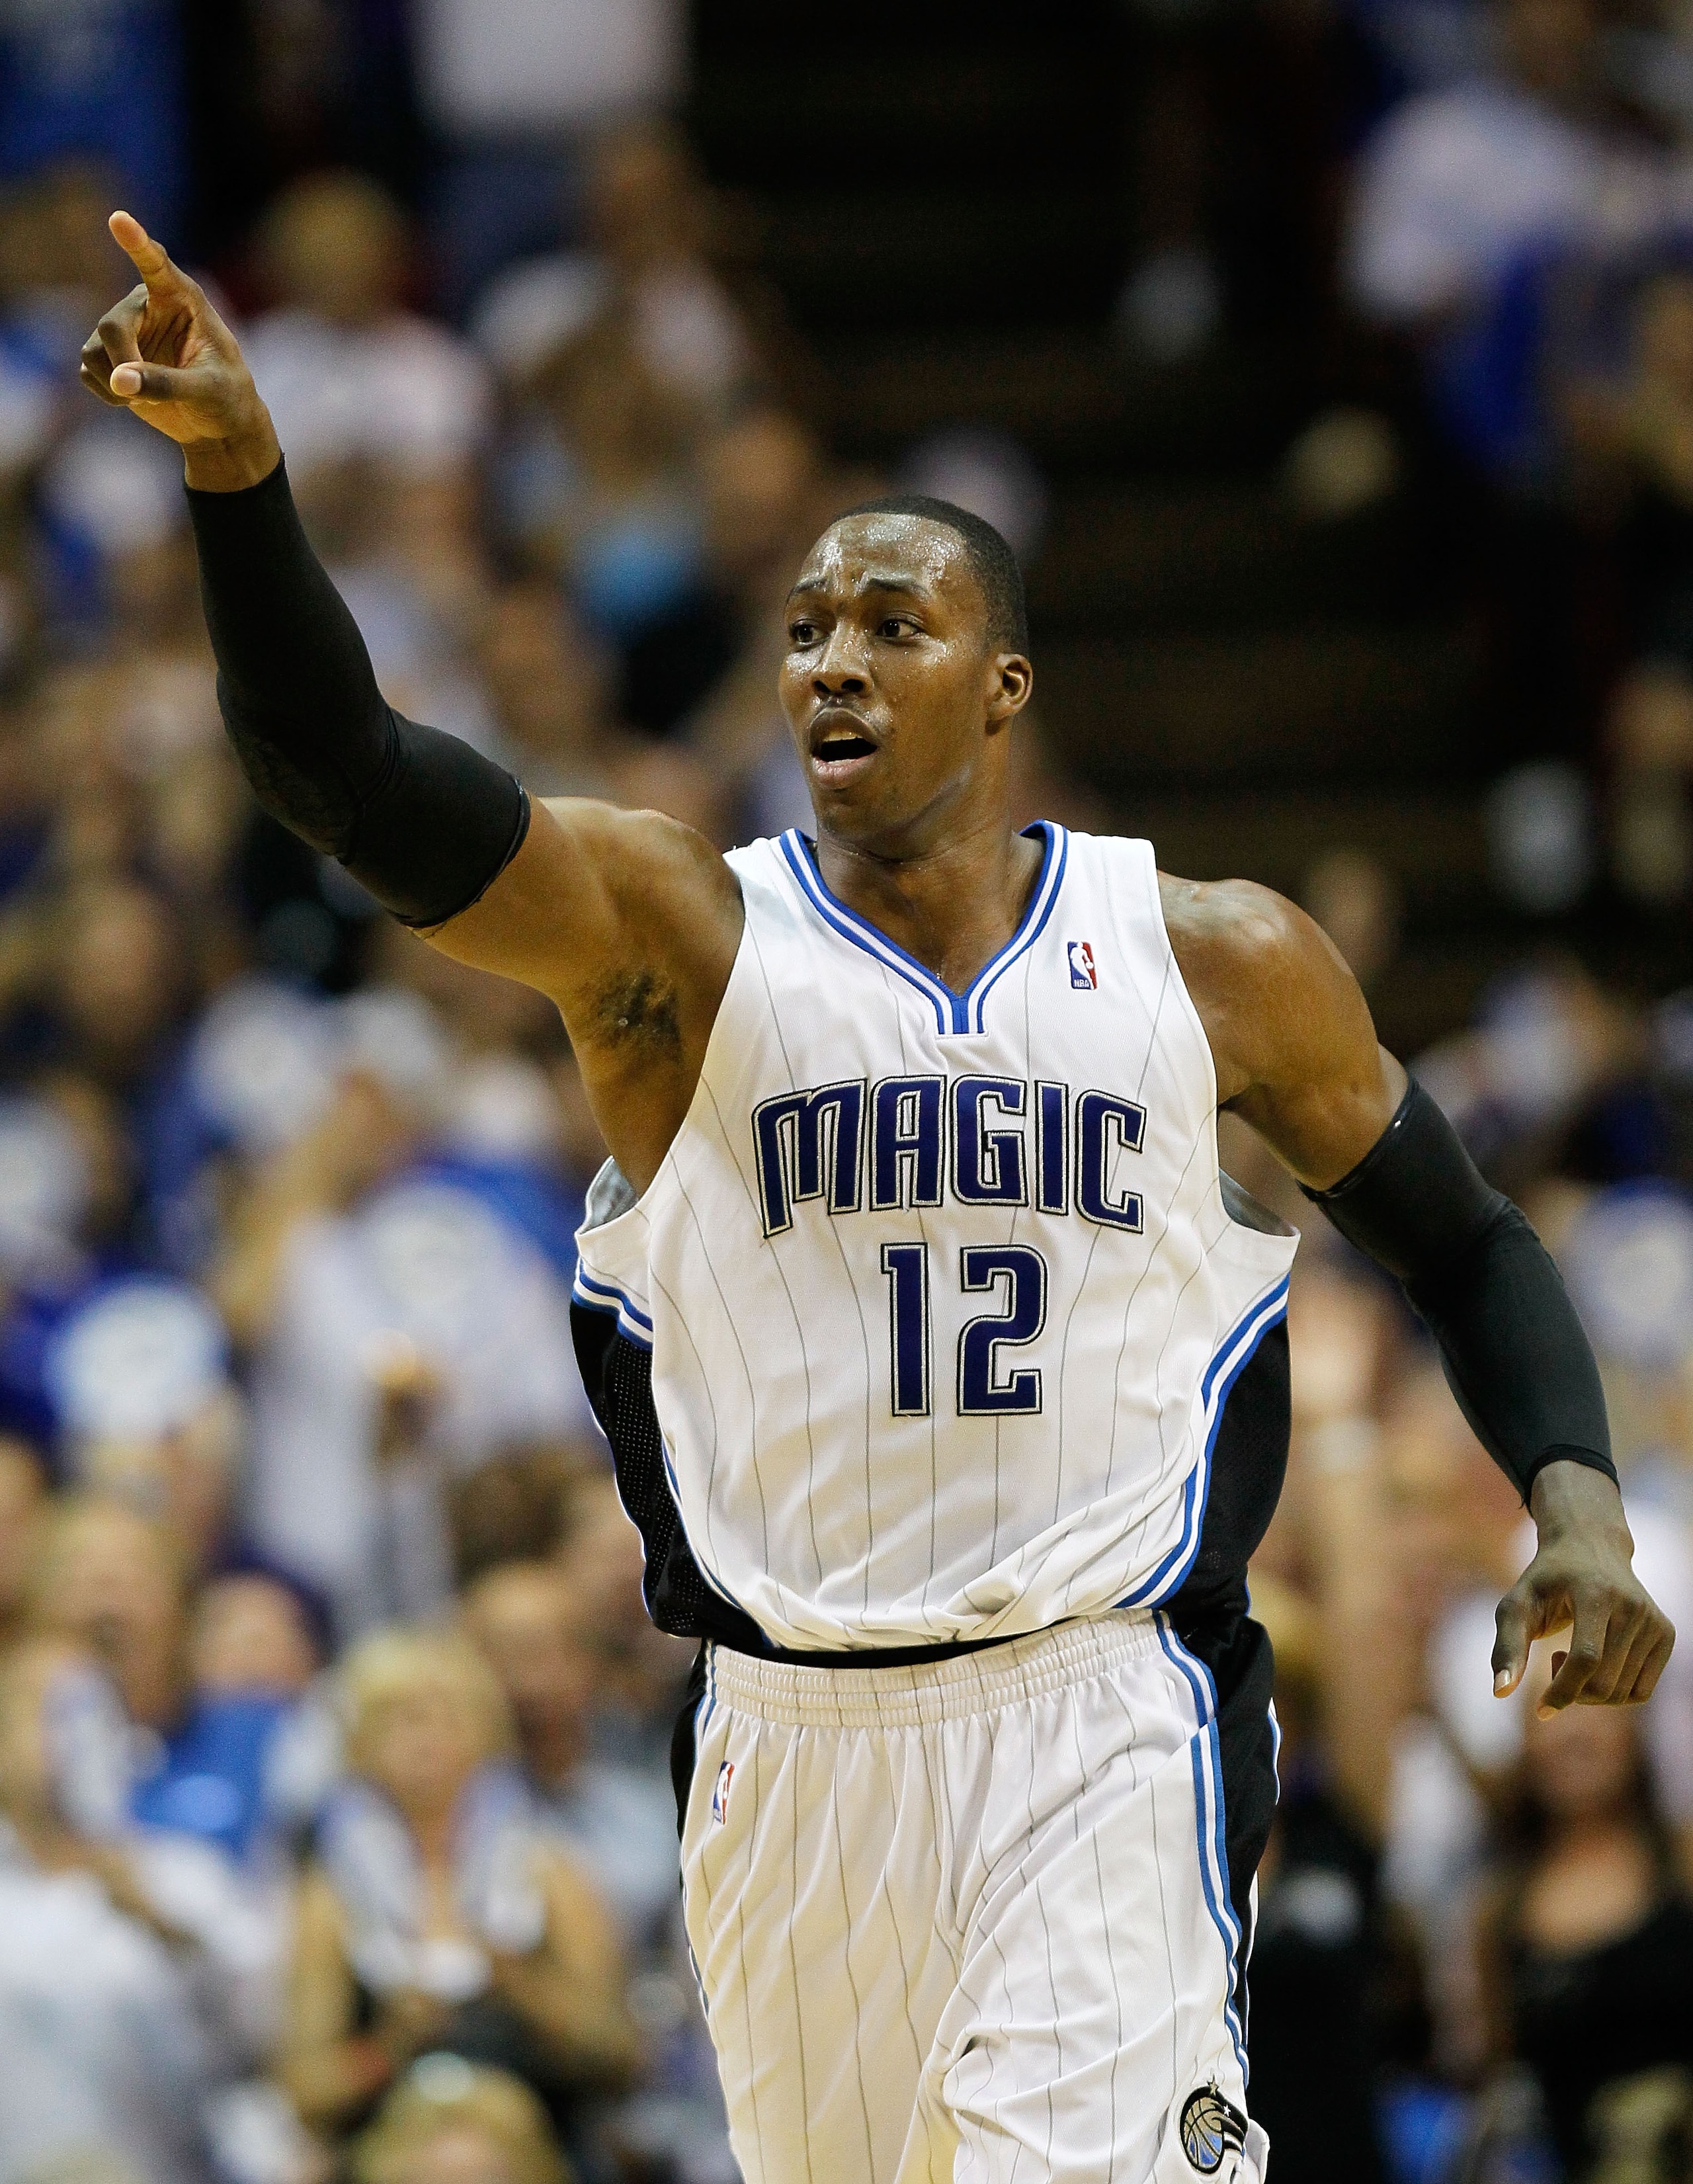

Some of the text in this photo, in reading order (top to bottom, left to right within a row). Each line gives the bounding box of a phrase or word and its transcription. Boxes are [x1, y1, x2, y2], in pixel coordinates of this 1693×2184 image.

[1074, 979, 1089, 987] NBA
[751, 1074, 1147, 1238] MAGIC
[880, 1241, 1048, 1417] 12
